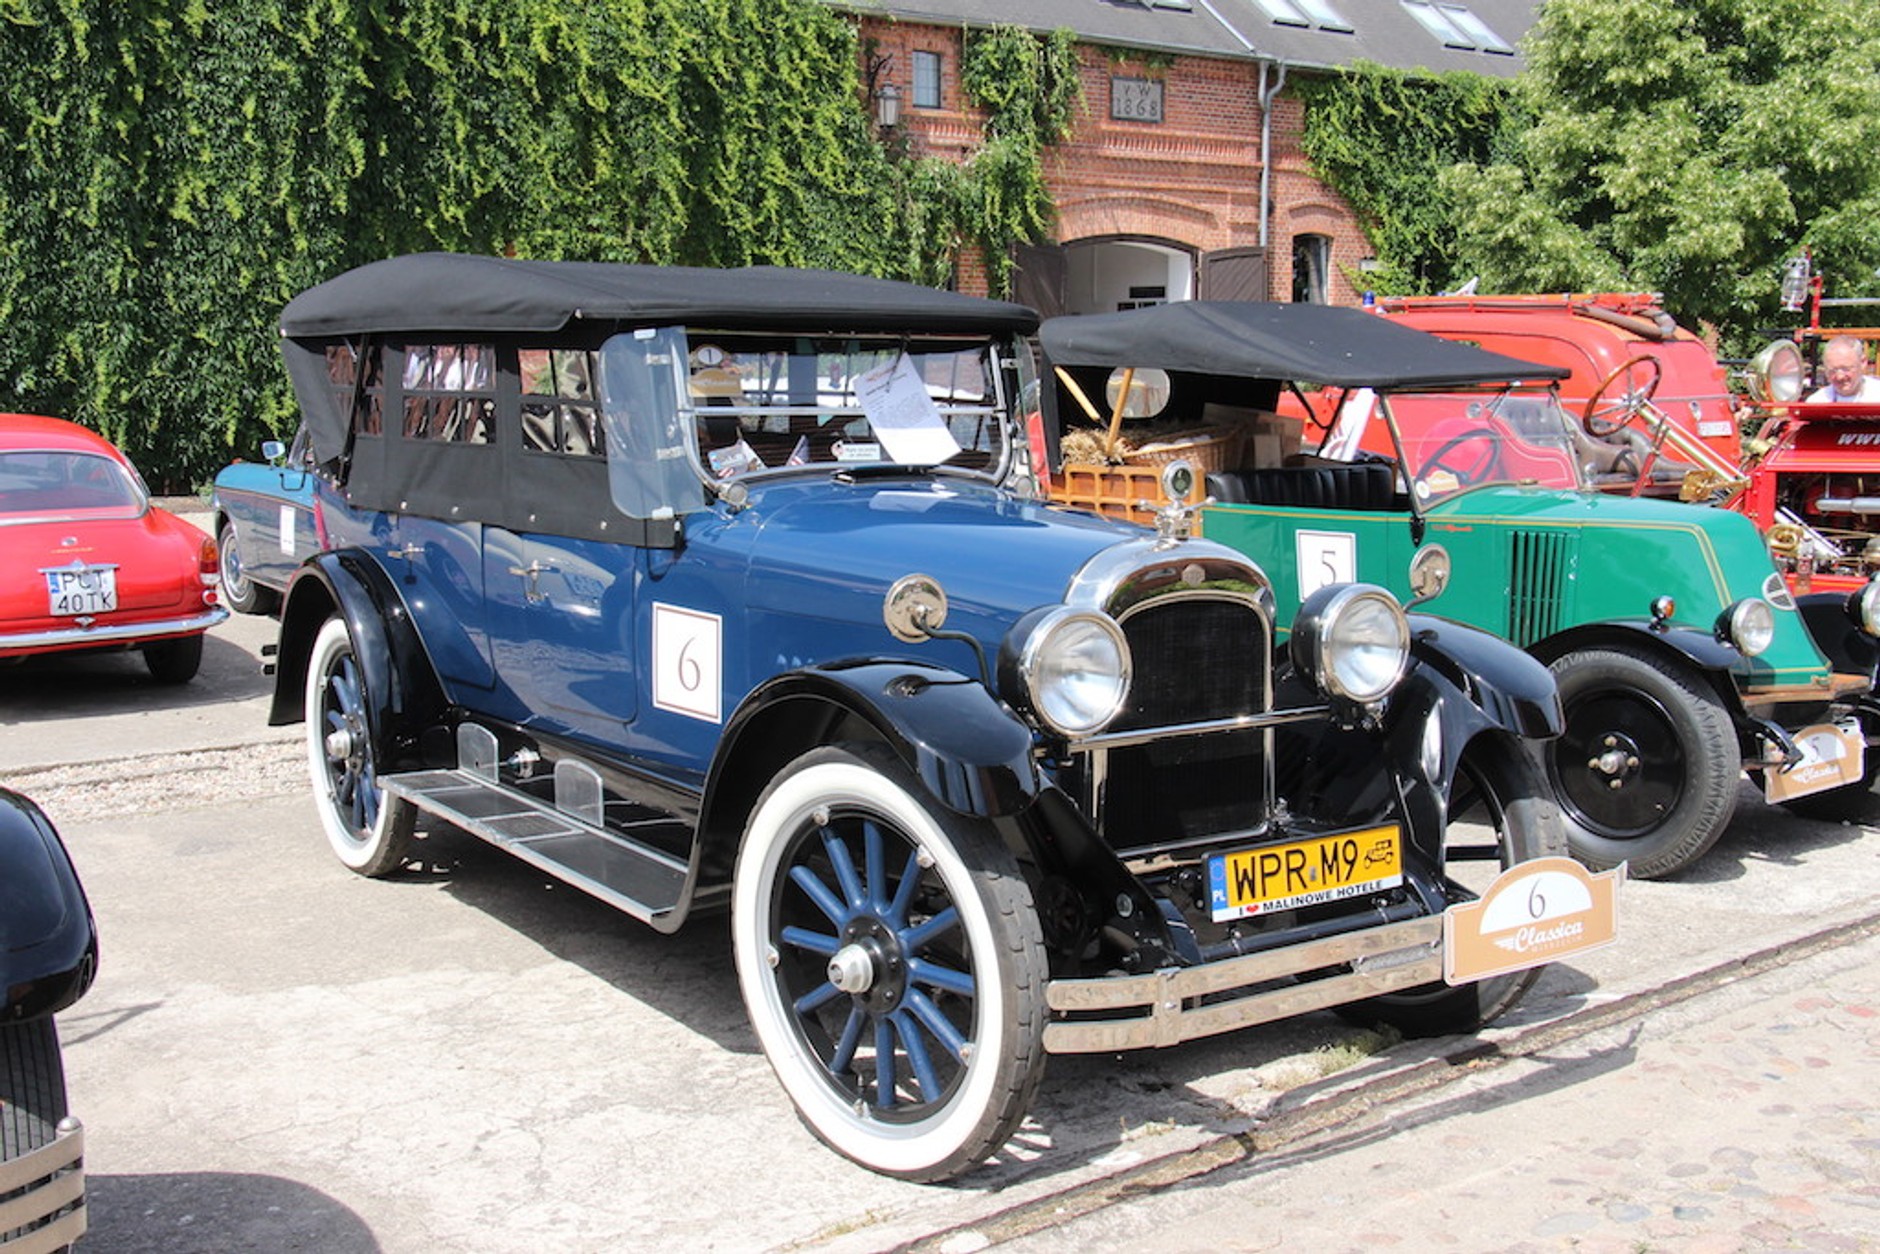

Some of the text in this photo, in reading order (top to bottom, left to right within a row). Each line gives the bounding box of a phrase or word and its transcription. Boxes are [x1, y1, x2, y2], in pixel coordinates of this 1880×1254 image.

[1116, 98, 1158, 117] 1868
[62, 569, 104, 591] PCT
[1320, 550, 1337, 589] 5
[58, 591, 113, 613] 40TK
[678, 635, 701, 692] 6
[1233, 839, 1359, 902] WPR M9
[1212, 889, 1226, 902] PL
[1262, 889, 1333, 912] MALINOWE
[1336, 879, 1383, 896] HOTELE
[1529, 876, 1546, 919] 6
[1514, 921, 1585, 952] Classica
